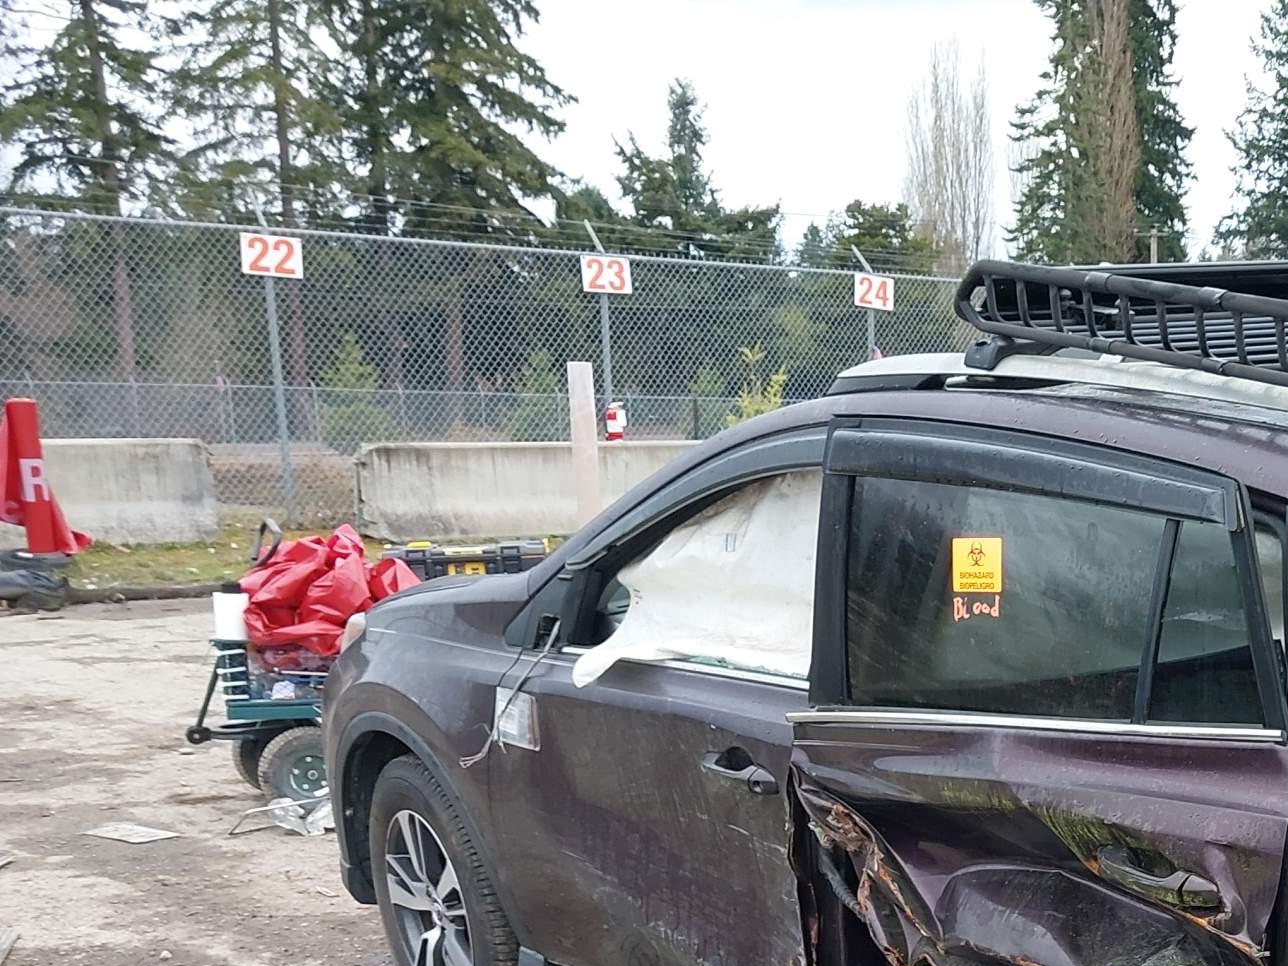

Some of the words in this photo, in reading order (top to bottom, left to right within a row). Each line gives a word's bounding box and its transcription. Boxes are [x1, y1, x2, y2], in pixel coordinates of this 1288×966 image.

[247, 237, 296, 275] 22
[586, 258, 626, 291] 23
[858, 276, 889, 307] 24
[953, 594, 1001, 622] Blood
